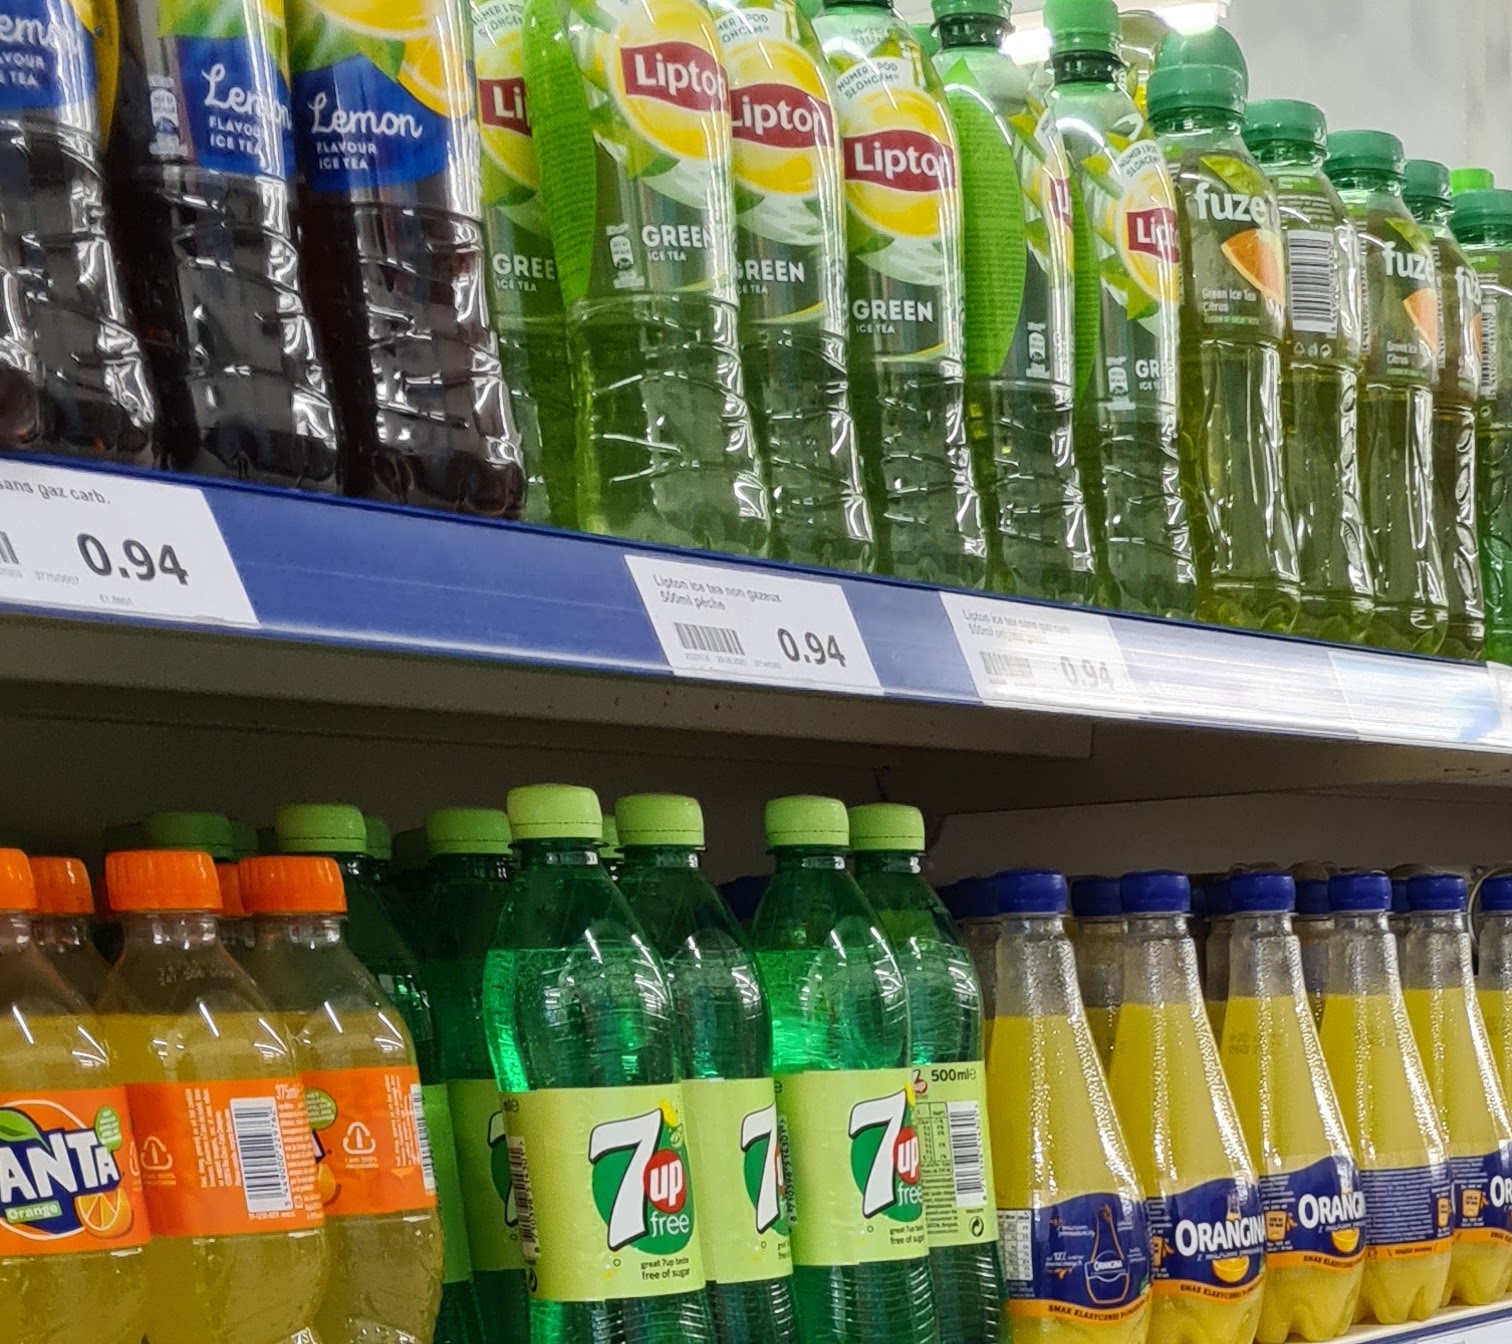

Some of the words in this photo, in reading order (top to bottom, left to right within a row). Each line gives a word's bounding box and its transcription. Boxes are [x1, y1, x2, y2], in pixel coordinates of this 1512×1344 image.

[203, 62, 292, 129] Lemon
[308, 92, 423, 140] Lemon
[210, 133, 235, 150] ICE
[316, 141, 377, 158] FLAVOUR
[319, 157, 341, 171] ICE
[344, 156, 369, 171] TEA
[1194, 183, 1270, 222] fuze
[641, 225, 714, 249] GREEN
[648, 251, 664, 262] ICE
[668, 251, 687, 262] TEA
[520, 279, 537, 292] TEA
[852, 301, 934, 322] GREEN
[856, 324, 873, 334] ICE
[876, 324, 895, 335] TEA
[39, 485, 68, 503] gaz
[71, 487, 111, 508] carb.
[77, 532, 189, 586] 0.94
[652, 574, 688, 593] Lipton
[777, 628, 846, 667] 0.94
[849, 1088, 907, 1219] 7
[0, 1130, 119, 1204] ANTA
[588, 1106, 663, 1252] 7
[649, 1159, 682, 1207] up
[651, 1210, 690, 1238] free
[641, 1268, 660, 1281] free
[661, 1268, 671, 1278] of
